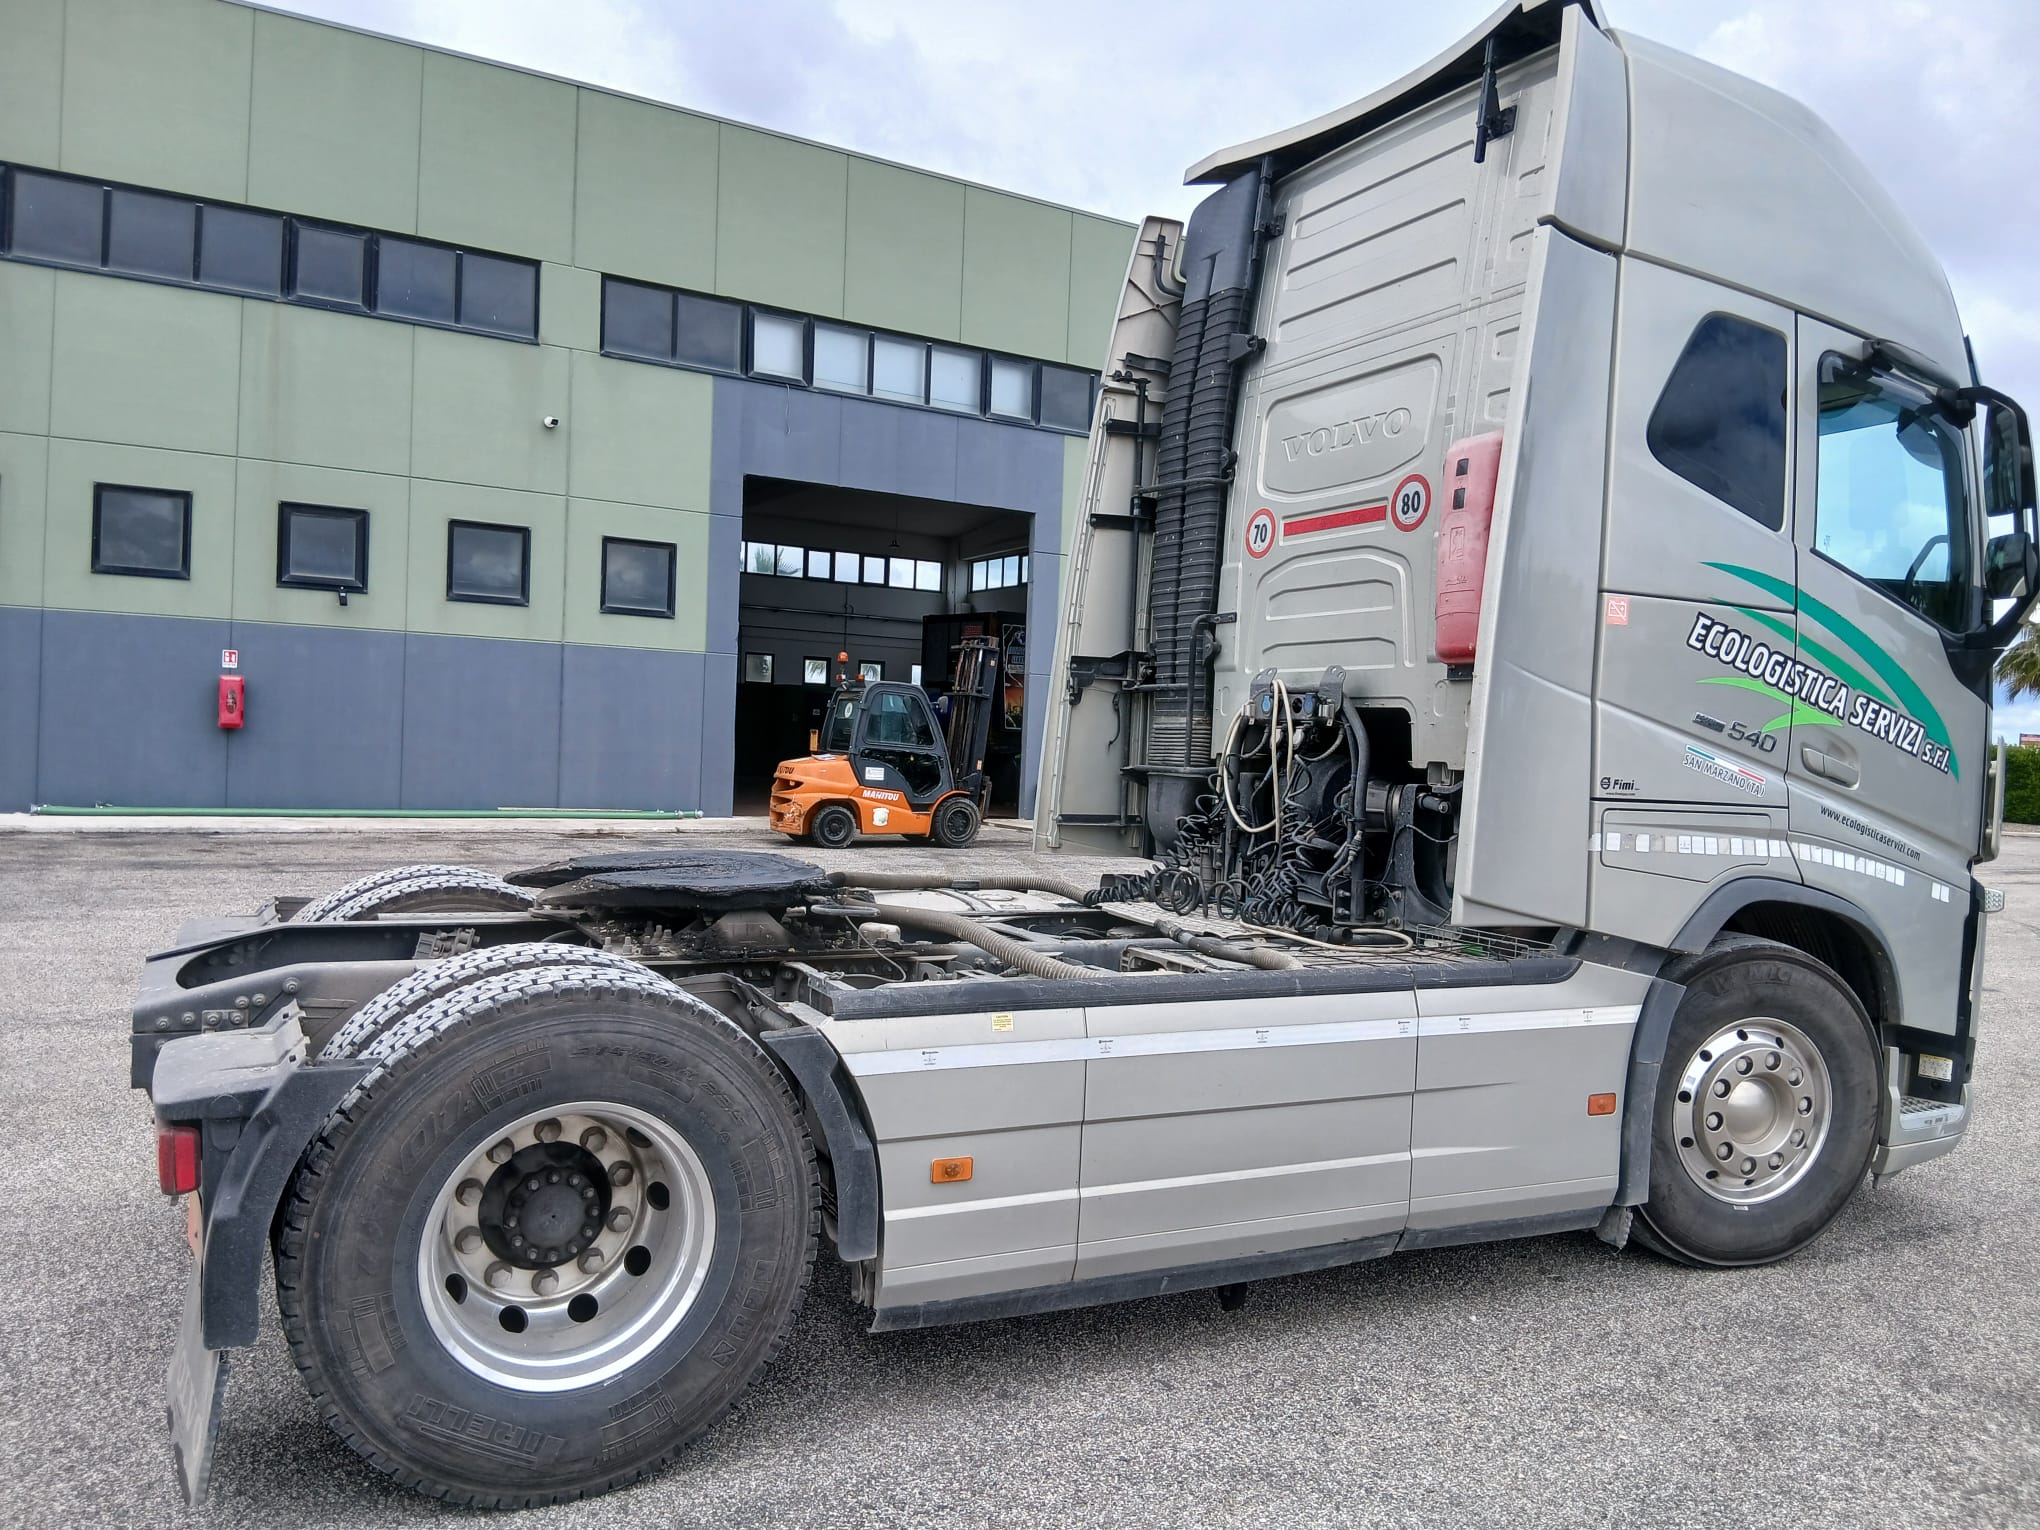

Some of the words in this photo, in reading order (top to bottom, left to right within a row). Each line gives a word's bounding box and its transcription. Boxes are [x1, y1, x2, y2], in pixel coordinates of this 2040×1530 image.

[1281, 407, 1412, 462] VOLVO
[1401, 490, 1421, 516] 80
[1253, 523, 1268, 545] 70
[1687, 611, 1849, 720] ECOLOGISTICA
[1848, 694, 1928, 757] SERVIZI
[1921, 740, 1952, 774] s.r.l.
[1727, 721, 1778, 753] 540
[1612, 778, 1635, 791] Fimi
[1683, 754, 1703, 771] SAN
[1703, 761, 1746, 788] MARZANO
[862, 789, 900, 801] MANITOU
[1820, 804, 1922, 862] www.ecologisticaservizi.com
